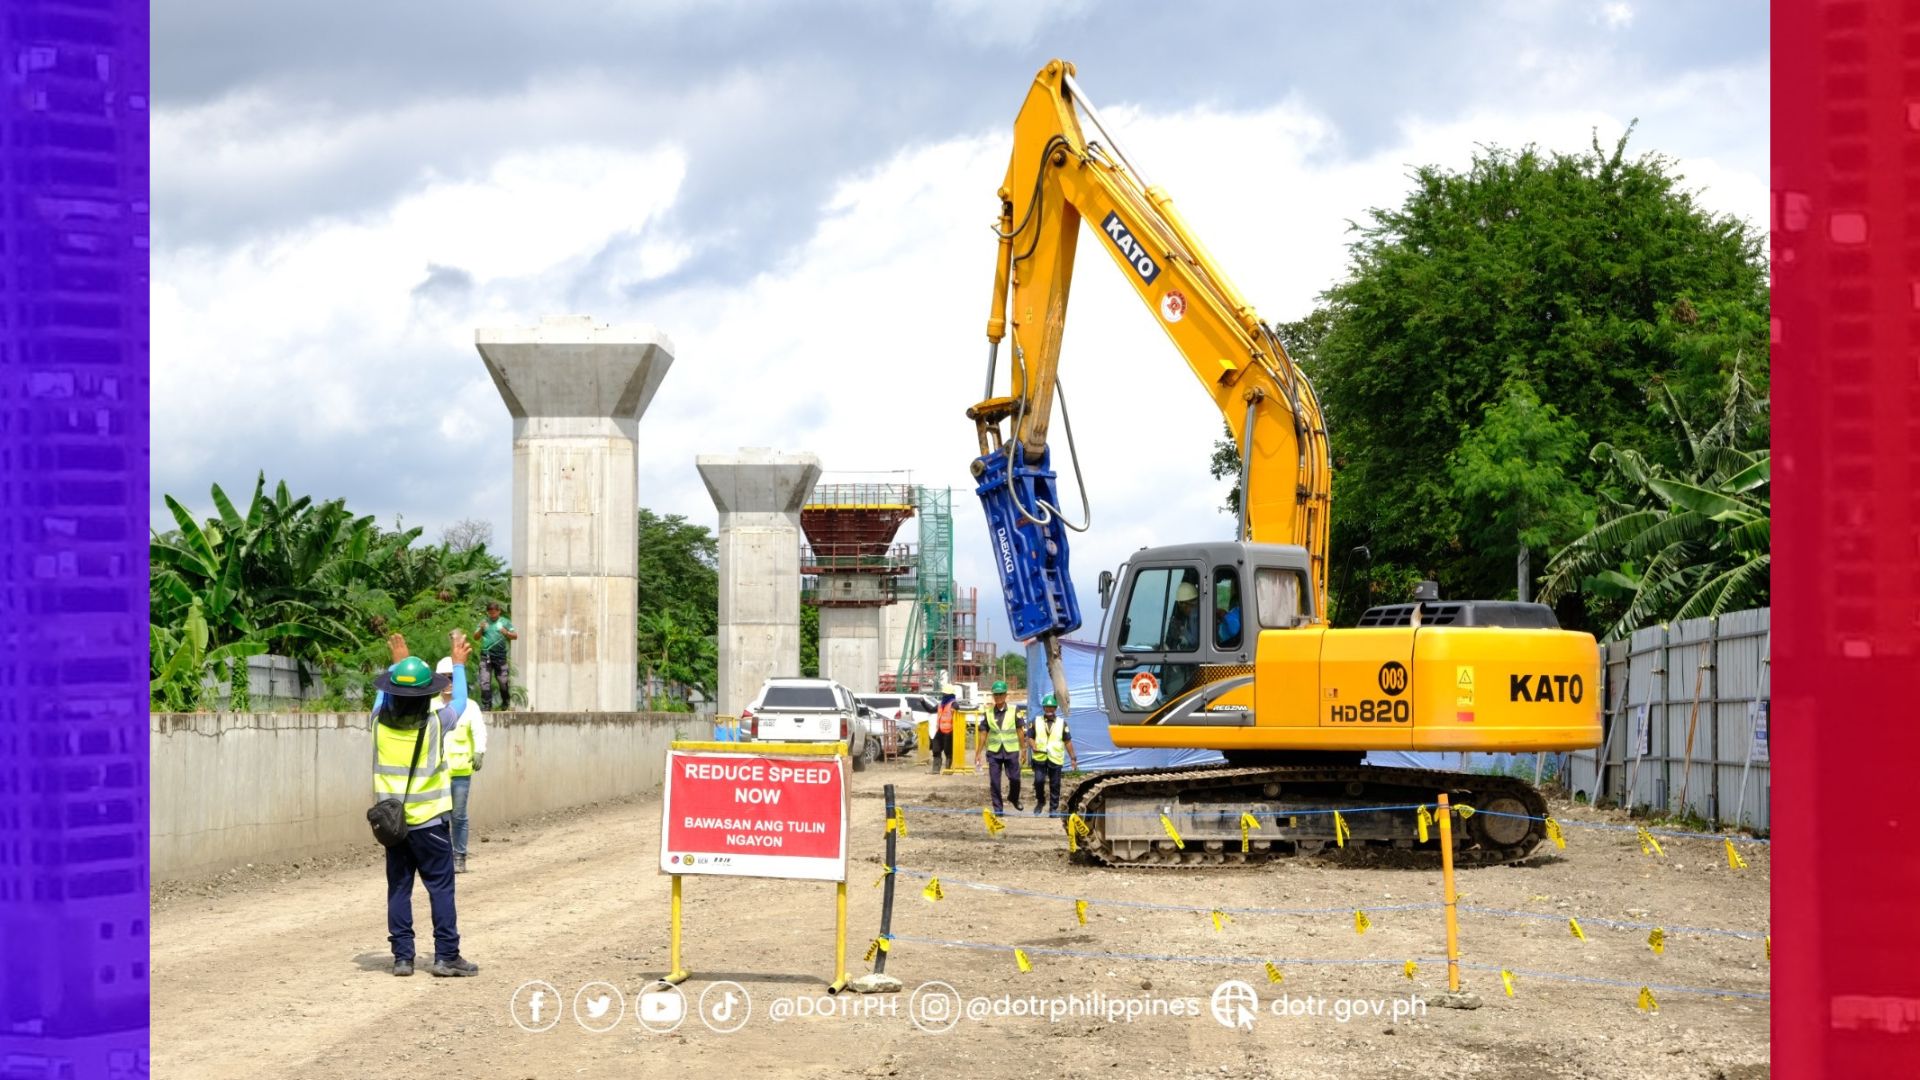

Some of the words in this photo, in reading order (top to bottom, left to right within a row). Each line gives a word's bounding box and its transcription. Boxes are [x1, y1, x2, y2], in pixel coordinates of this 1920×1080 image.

[1105, 216, 1154, 278] KATO
[997, 527, 1015, 573] DAEKKO
[1381, 665, 1406, 692] 003
[1510, 673, 1584, 703] KATO
[1330, 699, 1410, 723] HD820
[684, 763, 764, 781] REDUCE
[768, 765, 832, 784] SPEED
[734, 787, 781, 805] NOW
[683, 816, 752, 831] BAWASAN
[754, 819, 784, 833] ANG
[787, 821, 826, 834] TULIN
[726, 834, 783, 848] NGAYON
